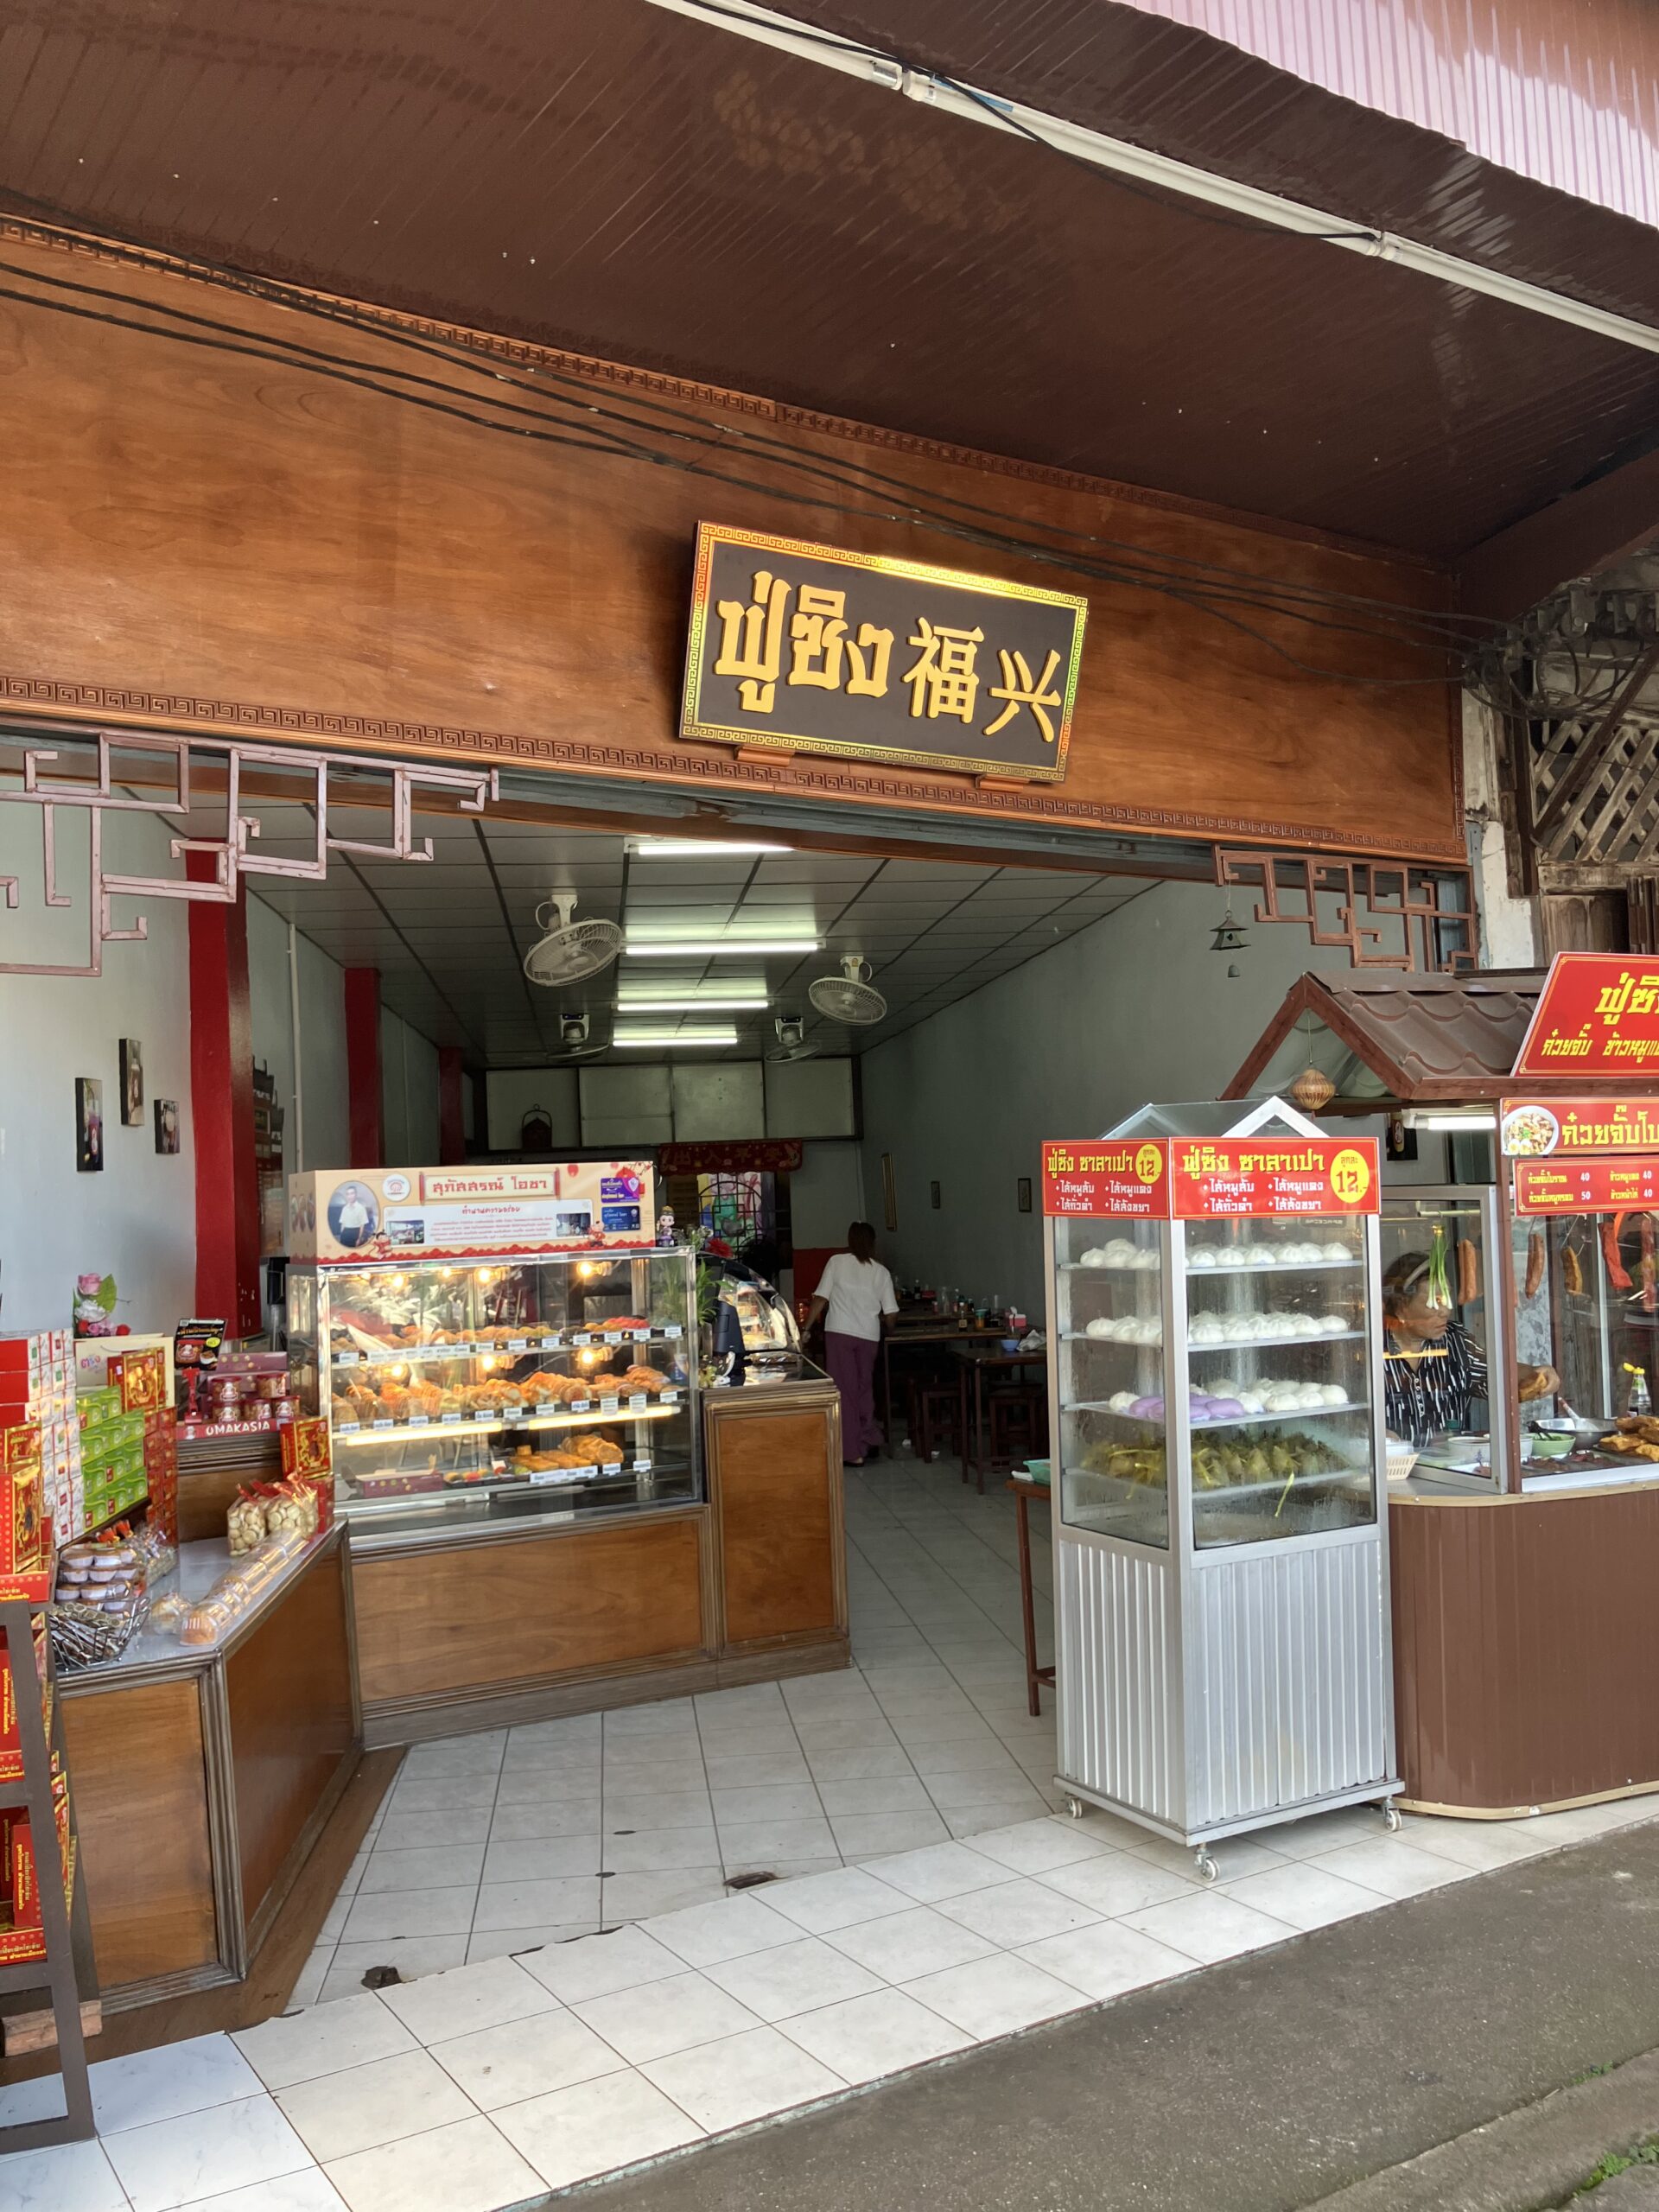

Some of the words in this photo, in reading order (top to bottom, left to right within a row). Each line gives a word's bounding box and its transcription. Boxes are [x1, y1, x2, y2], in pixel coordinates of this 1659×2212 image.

[715, 570, 895, 714] ฟู่ซิง
[902, 616, 1062, 743] 福兴
[1594, 972, 1659, 1025] ฟู่ซิ
[1047, 1147, 1074, 1179] ฟู่ซิง
[1079, 1149, 1134, 1173] ซาลาเปา
[1182, 1145, 1230, 1180] ฟู่ซิง
[1238, 1147, 1325, 1173] ซาลาเปา
[1340, 1156, 1358, 1167] ลูกละ
[1580, 1172, 1591, 1182] 40
[1643, 1170, 1652, 1179] 40
[1109, 1180, 1152, 1198] ไส้หมูแดง
[1209, 1178, 1255, 1196] ไส้หมูสับ
[1273, 1177, 1324, 1195] ไส้หมูแดง
[1581, 1191, 1591, 1200] 50
[1643, 1188, 1653, 1198] 40
[1059, 1194, 1093, 1211] ไส้ถั่วดำ
[1109, 1198, 1150, 1212] ไส้สังขยา
[1209, 1194, 1253, 1212] ไส้ถั่วดำ
[1273, 1196, 1322, 1211] ไส้สังขยา
